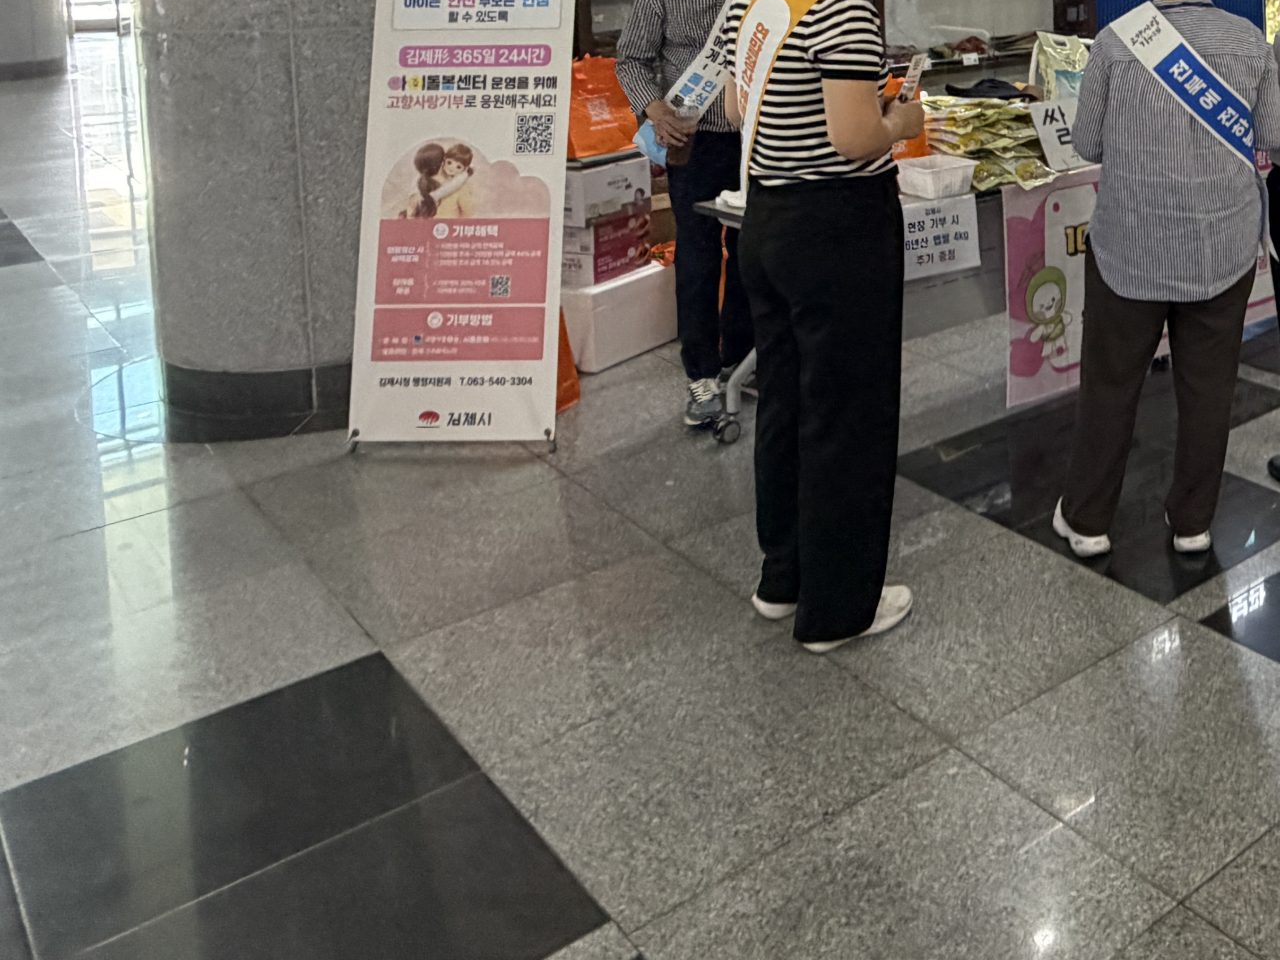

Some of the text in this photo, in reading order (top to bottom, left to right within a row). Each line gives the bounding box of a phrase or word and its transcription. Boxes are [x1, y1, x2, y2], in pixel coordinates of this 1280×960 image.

[461, 10, 473, 23] 수
[475, 9, 509, 23] 있도록
[452, 48, 495, 64] 365일
[498, 47, 545, 64] 24시간
[490, 76, 530, 90] 운영을
[532, 75, 558, 89] 위해
[386, 93, 557, 110] 고향사랑기부로 응원해주세요!
[1042, 105, 1073, 146] 쌀
[907, 214, 960, 234] 현장 기부 시
